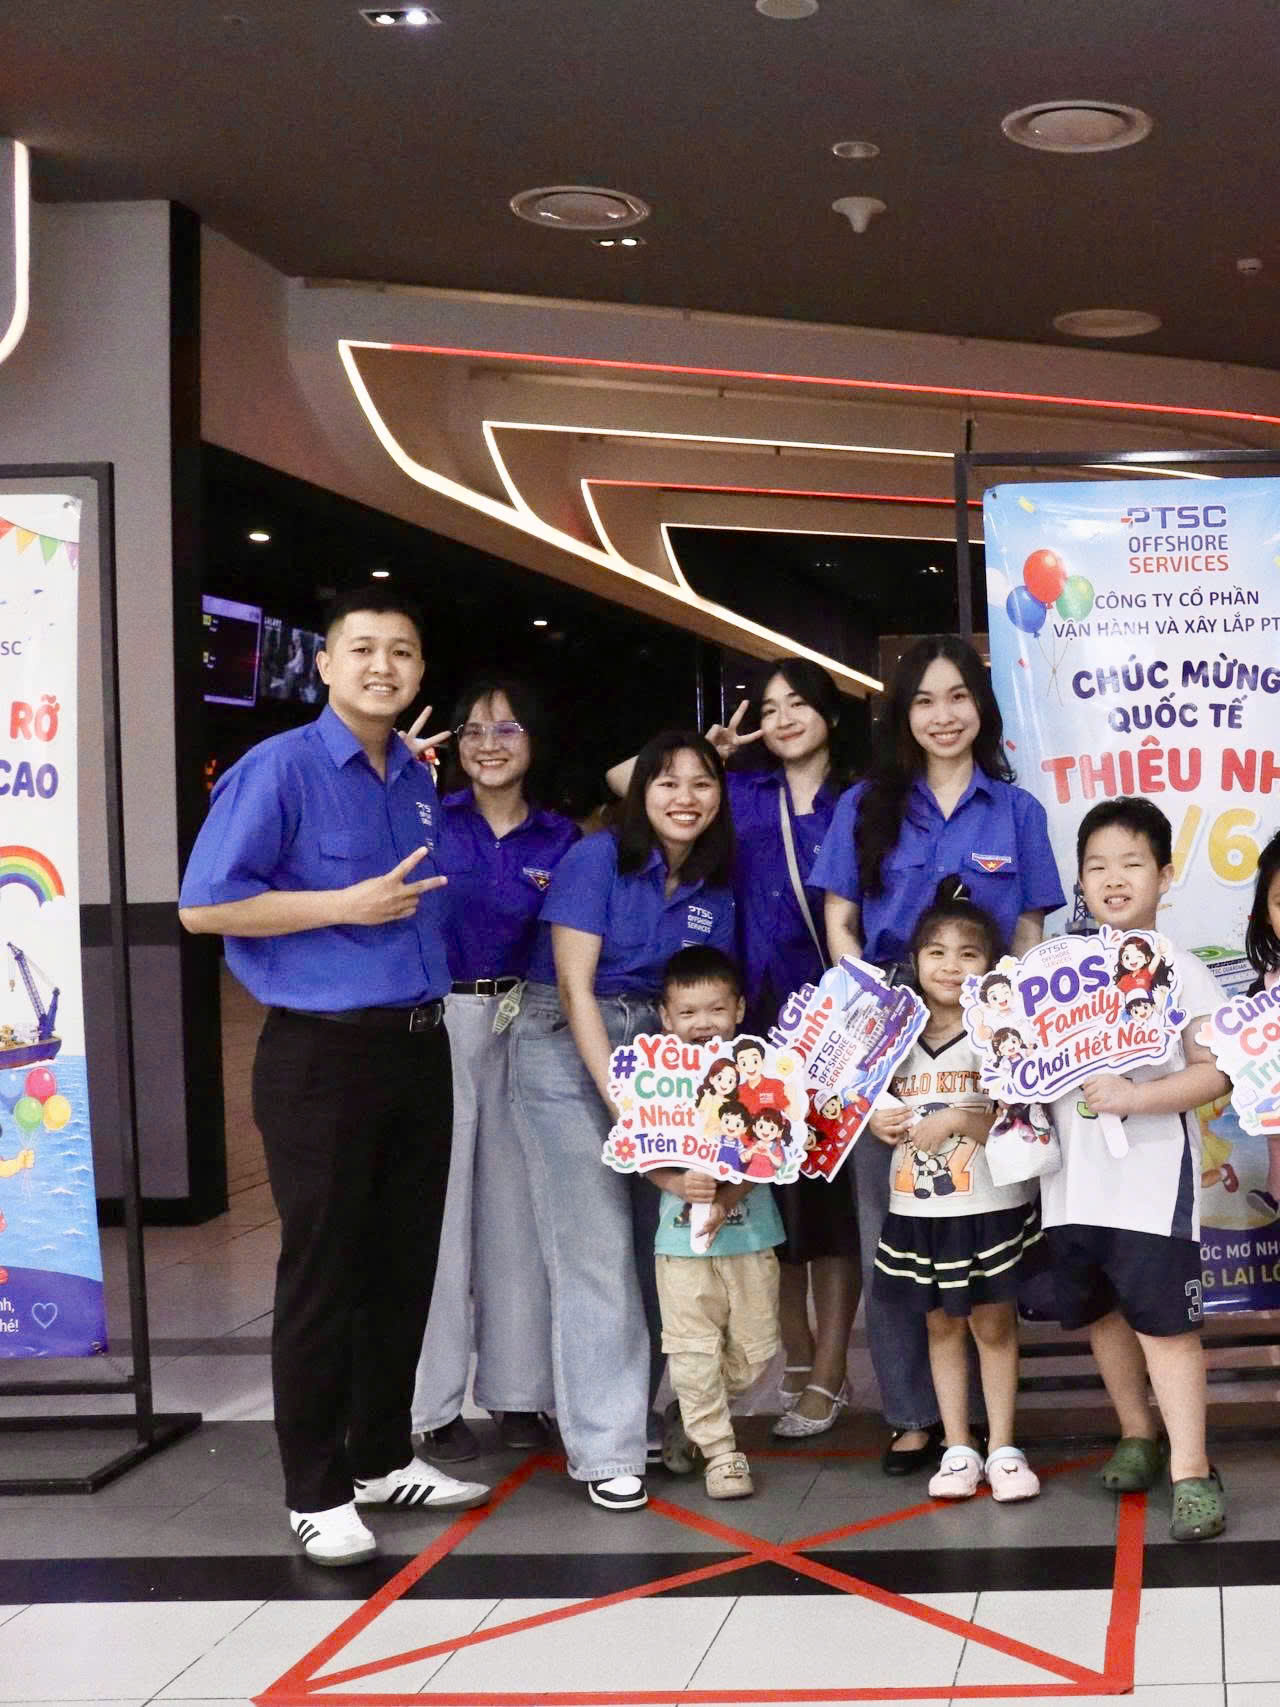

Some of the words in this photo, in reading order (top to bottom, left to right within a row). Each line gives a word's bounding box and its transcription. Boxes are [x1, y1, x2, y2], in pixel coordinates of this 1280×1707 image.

[1121, 505, 1228, 529] PTSC
[1128, 534, 1229, 553] OFFSHORE
[1129, 555, 1230, 574] SERVICES
[1095, 590, 1148, 610] CÔNG
[1152, 593, 1173, 609] TY
[1179, 585, 1204, 608] CỔ
[1209, 584, 1260, 607] PHẦN
[1053, 619, 1091, 641] VẬN
[1098, 616, 1150, 637] HÀNH
[1155, 616, 1180, 635] VÀ
[1184, 614, 1217, 634] XÂY
[1223, 612, 1255, 633] LẮP
[0, 641, 22, 656] SC
[1072, 654, 1169, 700] CHÚC
[10, 694, 61, 742] RỠ
[1108, 692, 1199, 734] QUỐC
[1208, 695, 1248, 729] TẾ
[1171, 805, 1261, 887] /6
[1018, 955, 1112, 1017] POS
[778, 983, 816, 1031] Gia
[1032, 988, 1123, 1048] Family
[808, 1030, 842, 1080] PTSC
[818, 1036, 850, 1084] OFFSHORE
[826, 1043, 857, 1089] SERVICES
[1019, 1049, 1071, 1090] Chơi
[1074, 1030, 1112, 1064] Hết
[1117, 1021, 1161, 1050] Nấc
[634, 1070, 693, 1099] Con
[893, 1073, 932, 1097] ELLO
[936, 1071, 990, 1095] KITT
[639, 1099, 696, 1129] Nhất
[634, 1132, 678, 1155] Trên
[681, 1134, 719, 1163] Đời
[1200, 1241, 1222, 1261] ỚC
[1227, 1241, 1251, 1259] MƠ
[1222, 1266, 1255, 1287] LAI
